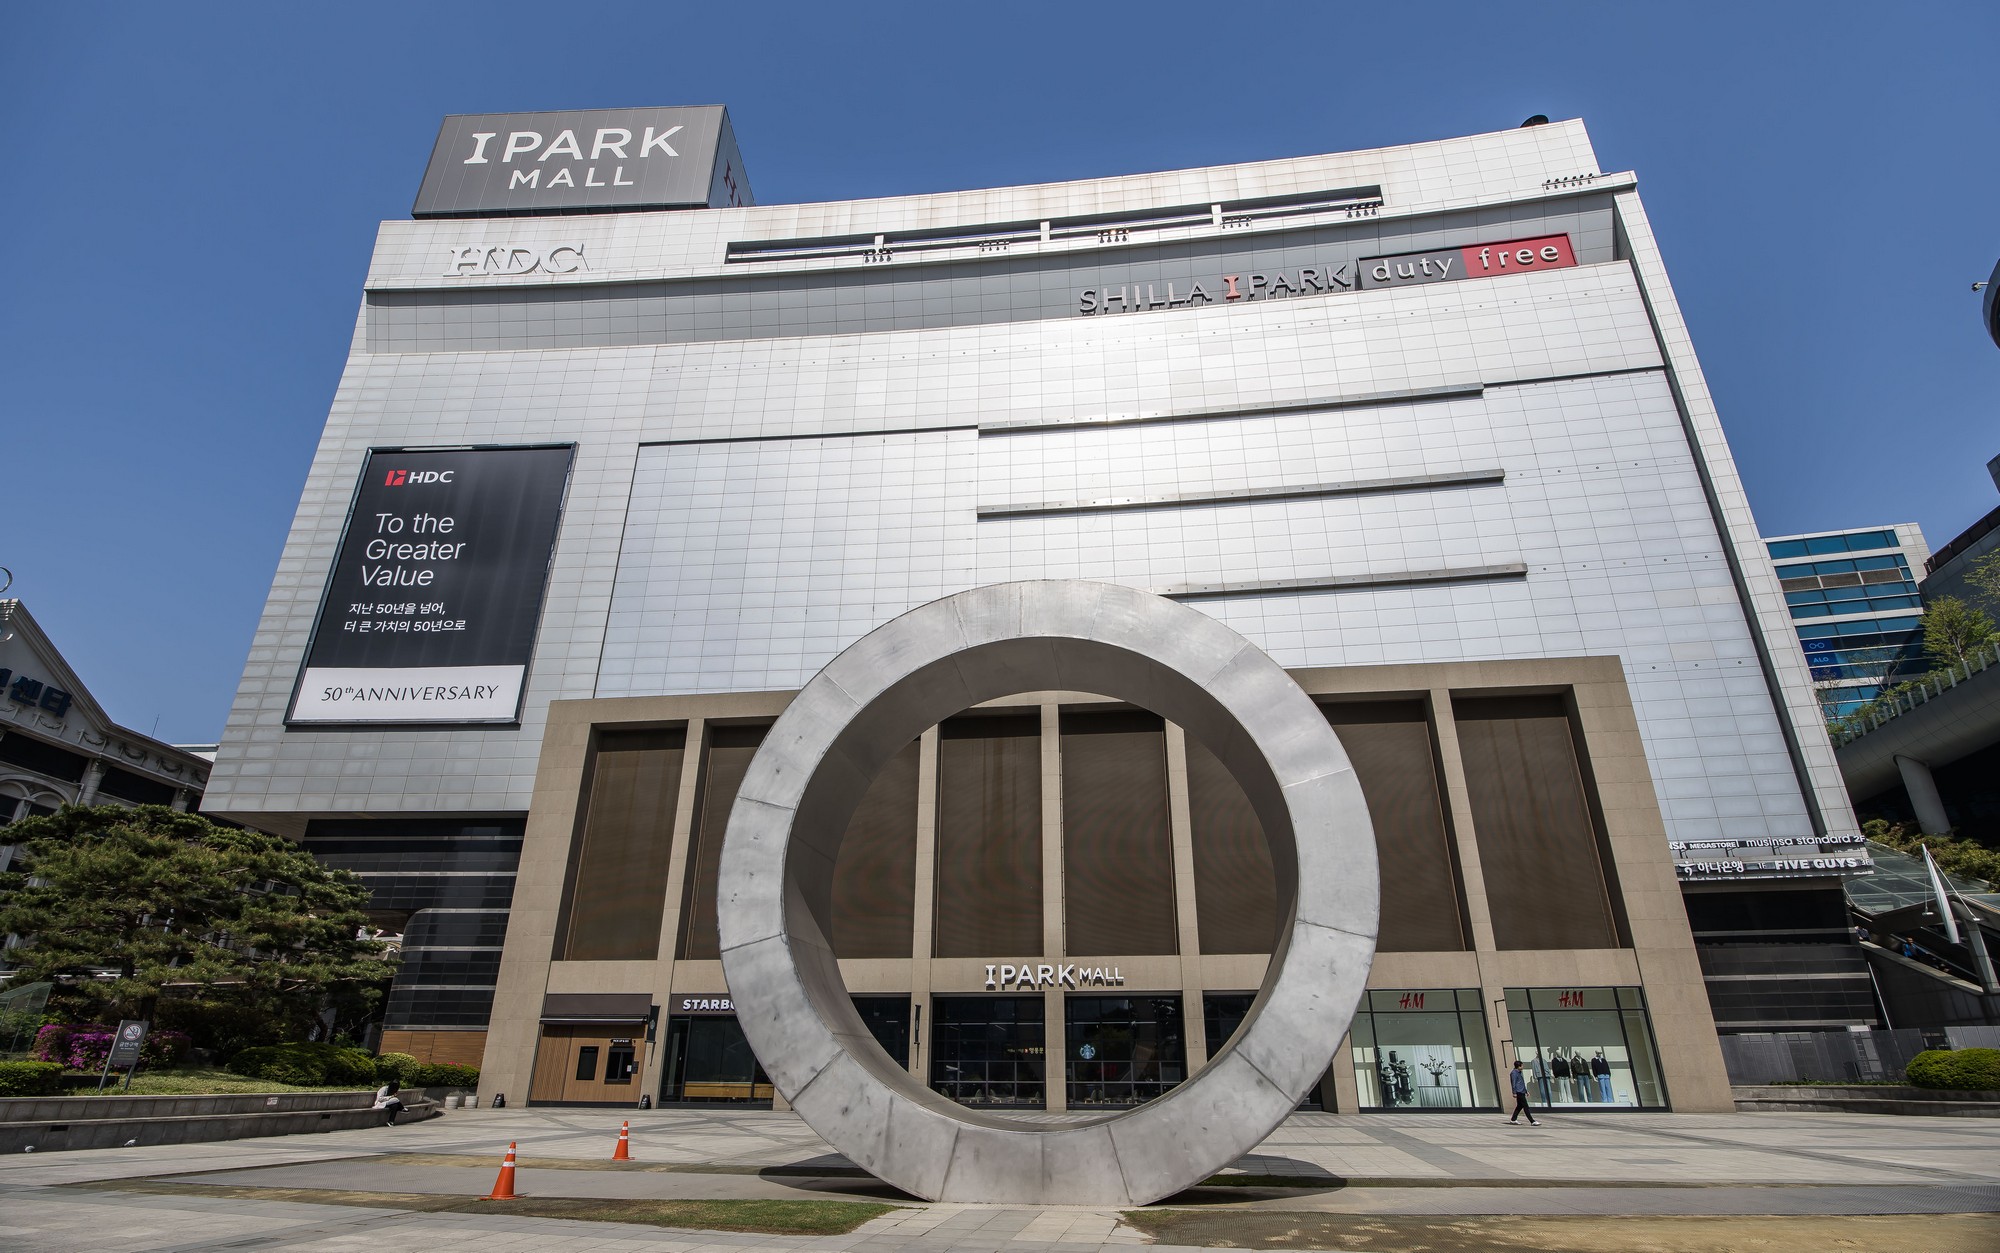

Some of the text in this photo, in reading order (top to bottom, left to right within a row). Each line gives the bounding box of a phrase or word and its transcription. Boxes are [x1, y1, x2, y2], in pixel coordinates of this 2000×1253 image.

[508, 166, 634, 190] MALL
[443, 243, 583, 277] HDC
[1371, 243, 1559, 282] duty free
[1079, 280, 1212, 313] SHILLA
[408, 470, 454, 484] HDC
[375, 512, 455, 534] To the
[366, 538, 466, 560] Greater
[361, 565, 434, 586] Value
[349, 602, 446, 615] 지난 50년을 넘어,
[344, 620, 466, 633] 더 큰 가치의 50년으로
[352, 685, 499, 701] ANNIVERSARY
[1746, 834, 1866, 847] musinsa standard 2F
[1697, 861, 1744, 873] 하나은행
[1775, 859, 1810, 870] FIVE
[1813, 858, 1857, 869] GUYS
[1079, 967, 1124, 980] MALL
[1398, 992, 1425, 1010] H&M
[1558, 990, 1584, 1008] H&M
